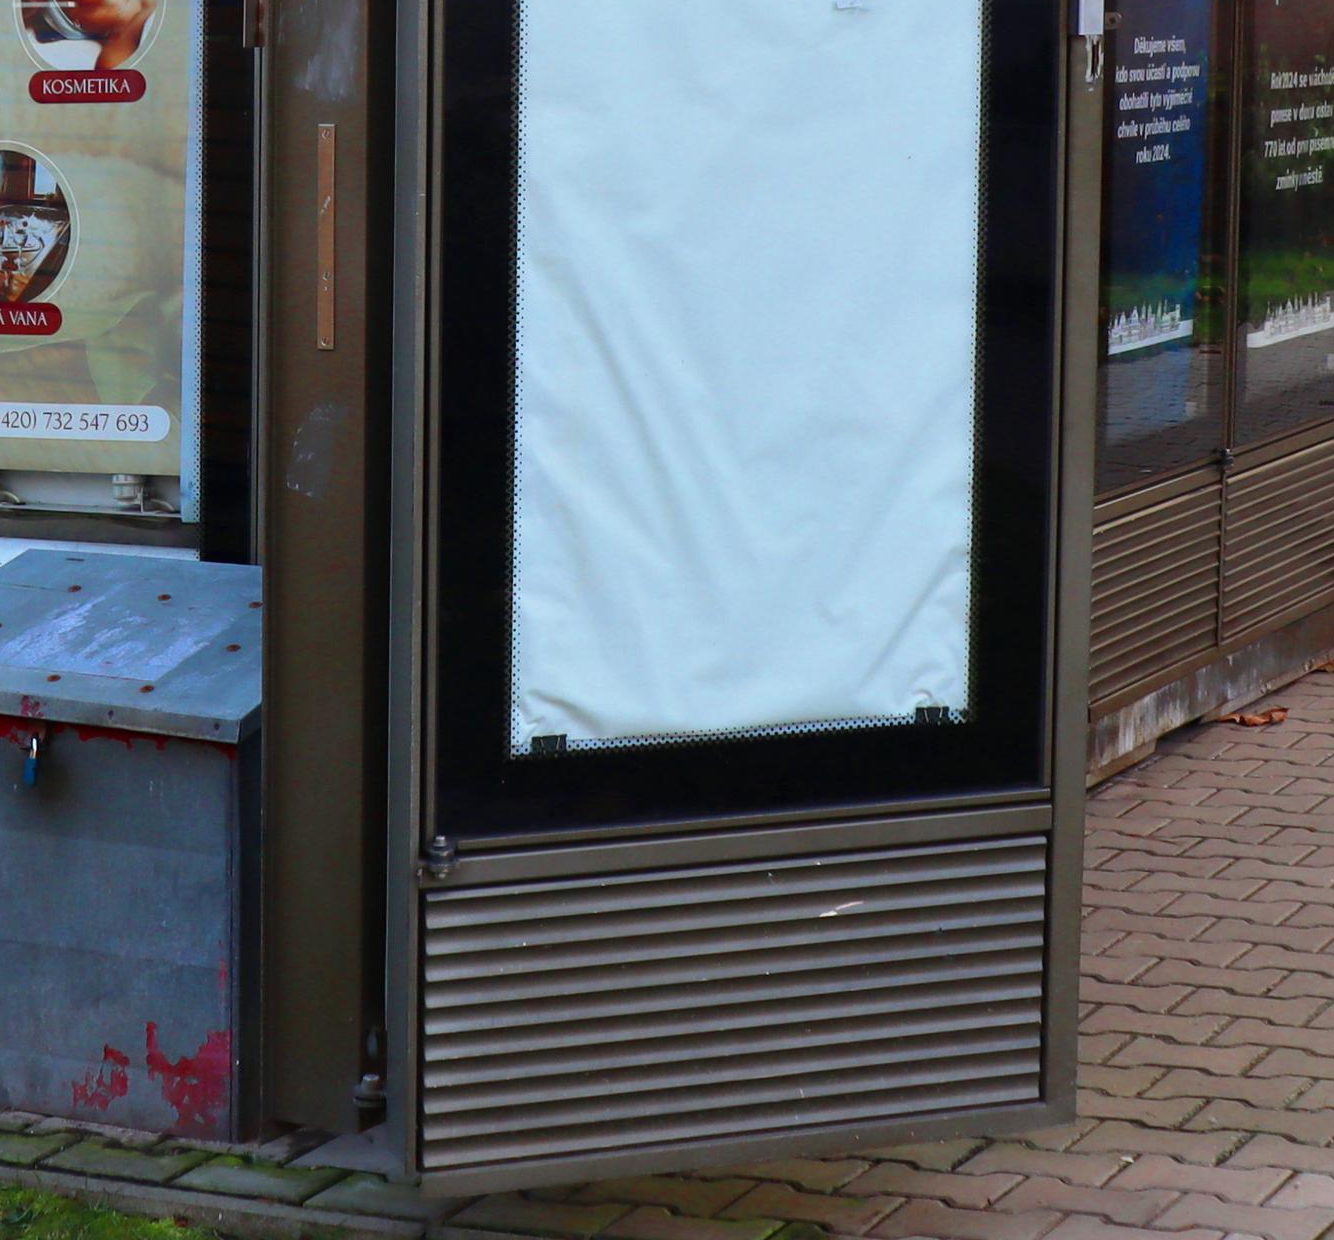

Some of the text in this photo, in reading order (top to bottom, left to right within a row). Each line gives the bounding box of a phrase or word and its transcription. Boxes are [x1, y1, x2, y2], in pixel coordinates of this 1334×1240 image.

[42, 78, 131, 95] KOSMETIKA
[9, 310, 47, 326] VANA
[42, 411, 73, 431] 732
[78, 412, 110, 431] 547
[116, 413, 149, 433] 693
